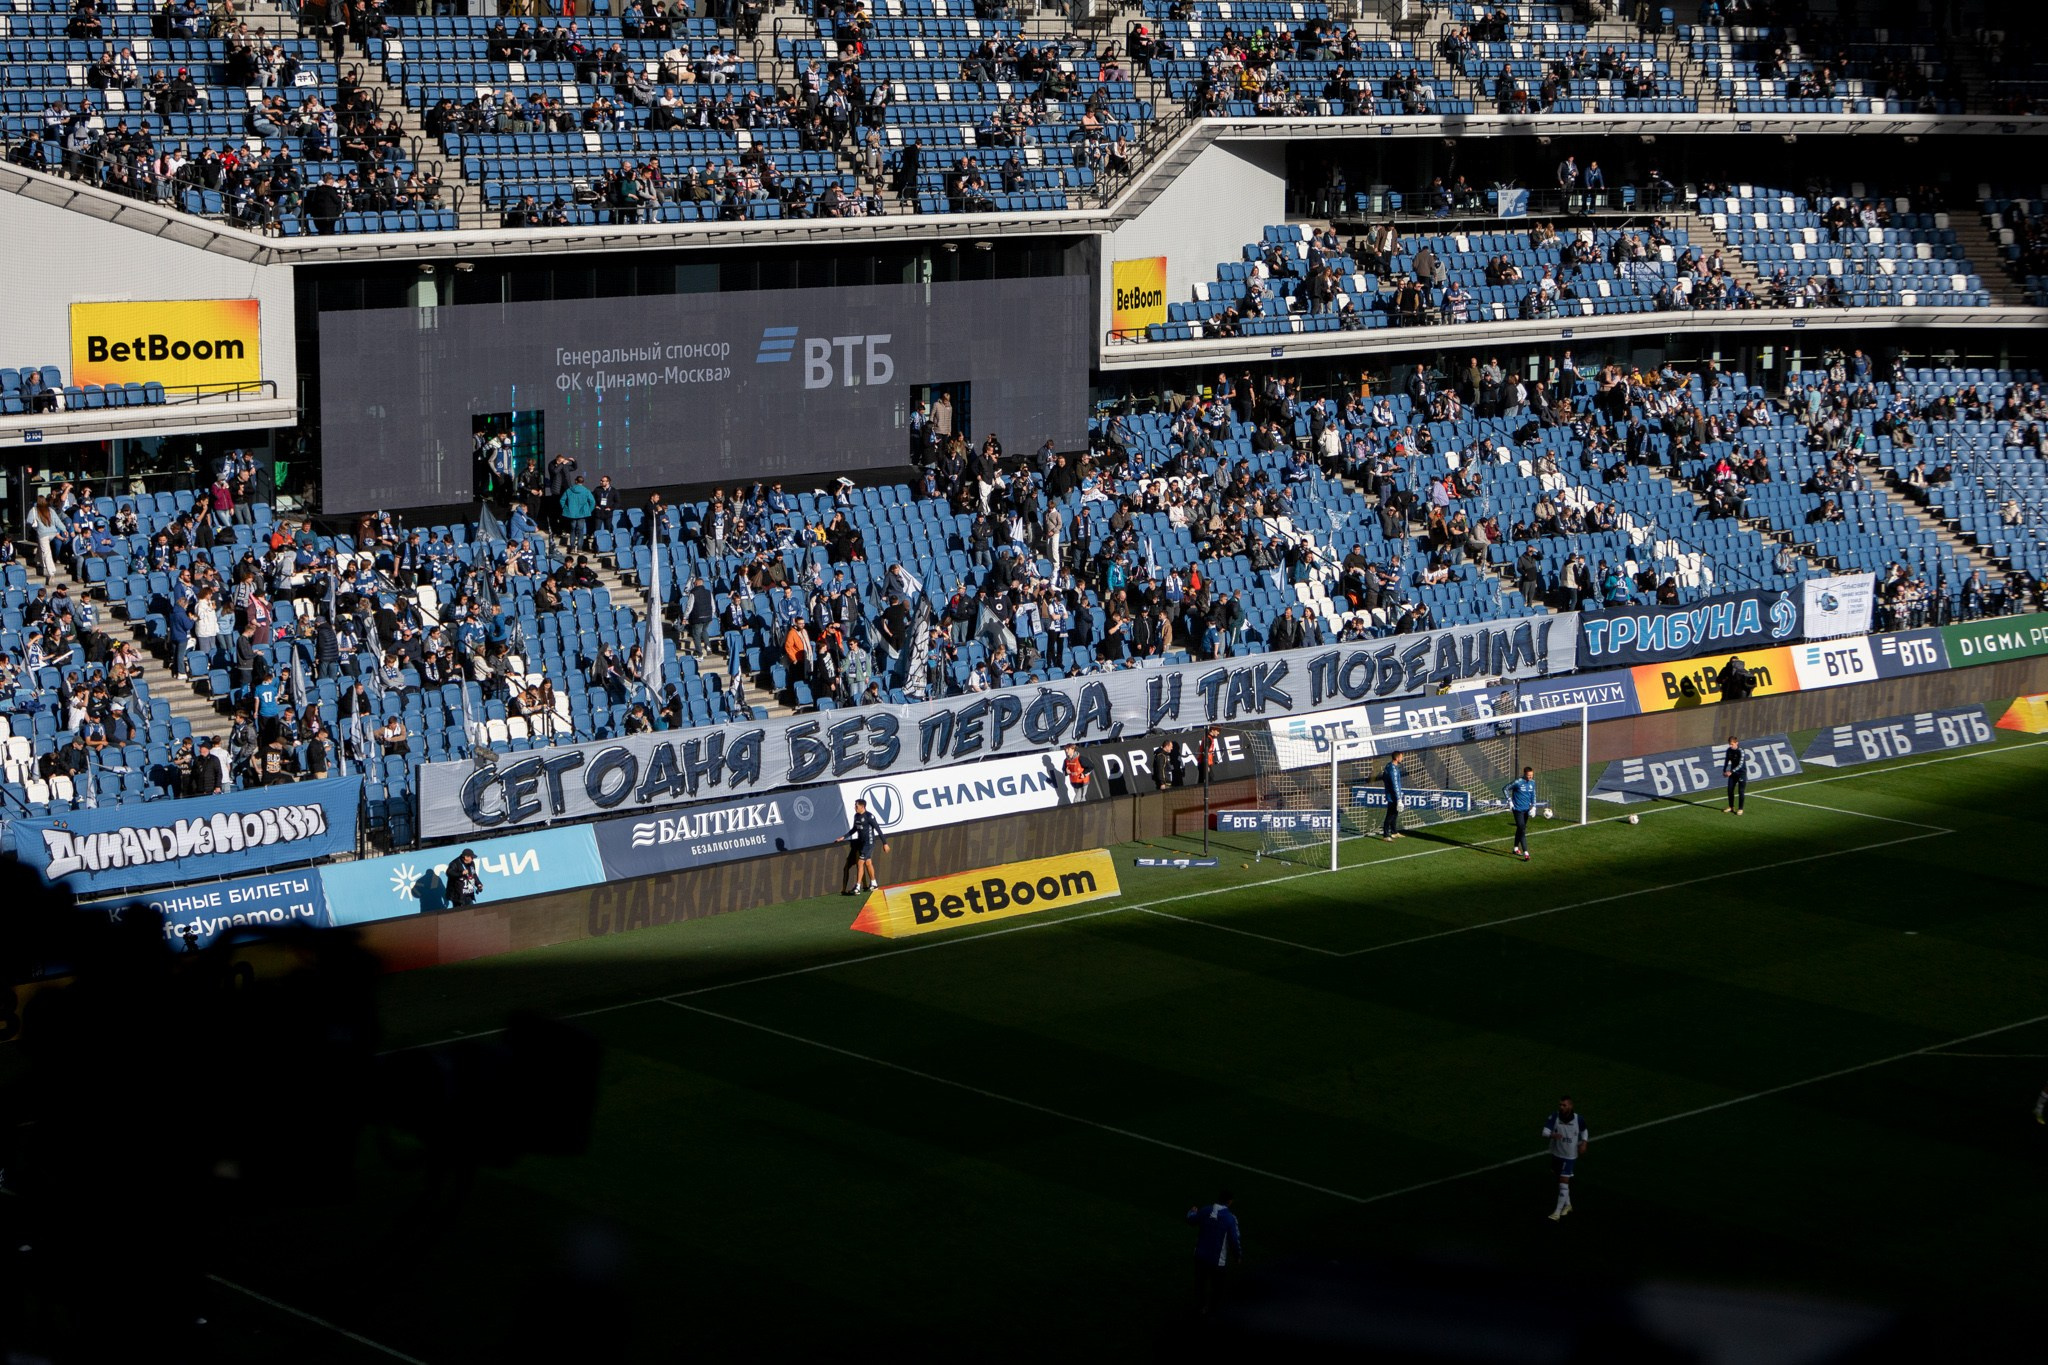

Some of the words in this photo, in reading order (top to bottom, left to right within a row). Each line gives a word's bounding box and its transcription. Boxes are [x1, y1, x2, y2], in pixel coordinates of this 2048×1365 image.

[1117, 287, 1162, 311] BetBoom
[88, 334, 244, 362] BetBoom
[556, 341, 661, 368] Генеральный
[666, 342, 730, 362] спонсор
[804, 334, 895, 389] ВТБ
[556, 372, 581, 392] ФК
[586, 365, 731, 393] «Динамо-Москва»
[1584, 599, 1762, 655] ТРИБУНА
[1898, 637, 1937, 667] ВТБ
[1960, 631, 2026, 656] DIGMA
[1824, 648, 1864, 677] ВТБ
[1539, 685, 1625, 709] ПРЕМИУМ
[1661, 664, 1772, 700] BetBm
[459, 728, 765, 827] СЕГОДНЯ
[785, 713, 900, 783] БЕЗ
[918, 681, 1124, 764] ПЕРФА,
[1146, 671, 1183, 728] И
[1196, 659, 1293, 722] ТАК
[1307, 618, 1553, 706] ПОБЕДИМ!
[1311, 719, 1359, 753] ВТБ
[1405, 705, 1452, 738] ВТБ
[1937, 711, 1990, 747] ВТБ
[1857, 723, 1913, 760] ВТБ
[1649, 756, 1710, 797] ВТБ
[1744, 742, 1797, 781] ВТБ
[912, 770, 1058, 810] CHANGAN
[1404, 795, 1427, 807] ВТБ
[1441, 796, 1464, 808] ВТБ
[658, 801, 784, 844] БАЛТИКА
[1233, 816, 1257, 829] ВТБ
[1273, 816, 1297, 828] ВТБ
[691, 834, 767, 856] БЕЗАЛКОГОЛЬНОЕ
[228, 878, 309, 904] БИЛЕТЫ
[588, 866, 724, 936] СТАВКИ
[726, 858, 774, 913] НА
[910, 870, 1097, 925] BetBoom
